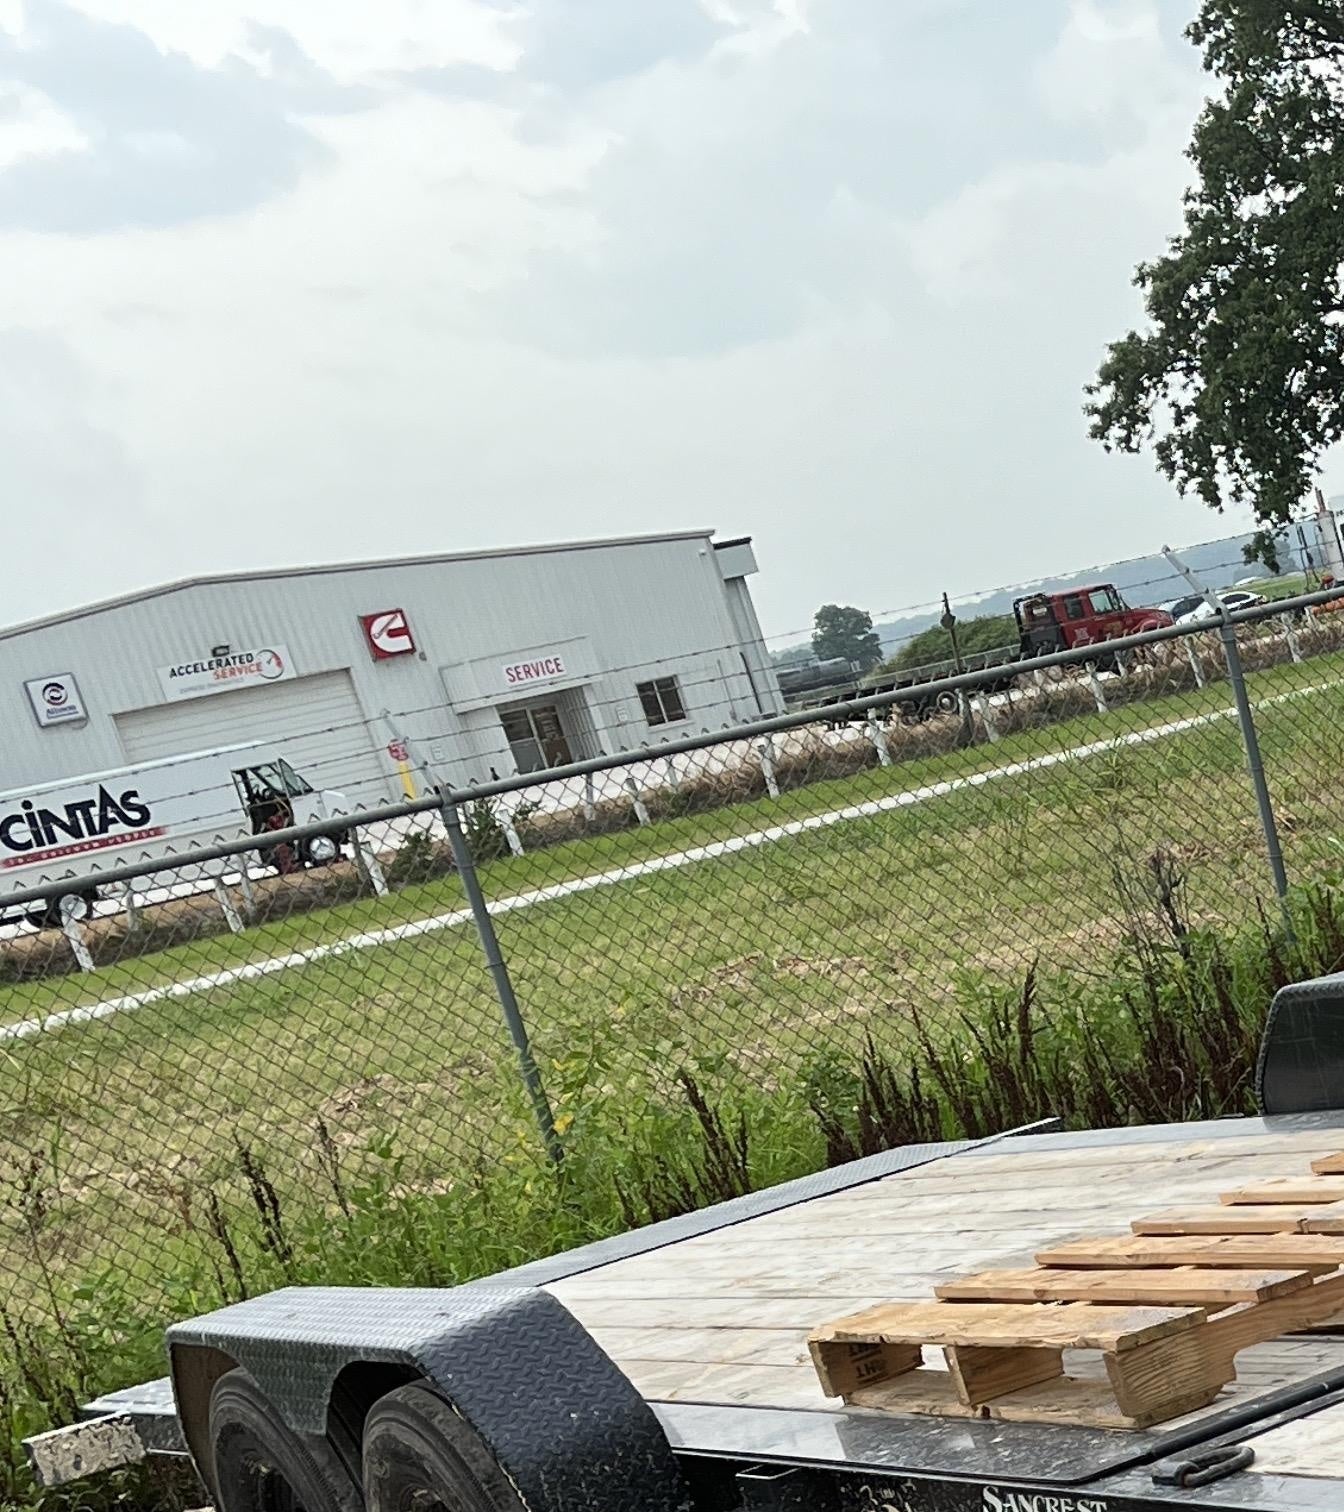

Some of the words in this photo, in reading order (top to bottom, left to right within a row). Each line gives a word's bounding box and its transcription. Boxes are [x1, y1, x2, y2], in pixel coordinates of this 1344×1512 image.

[169, 652, 255, 679] ACCELERATED
[213, 661, 263, 681] SERVICE
[505, 657, 564, 684] SERVICE
[0, 783, 151, 852] CINTAS
